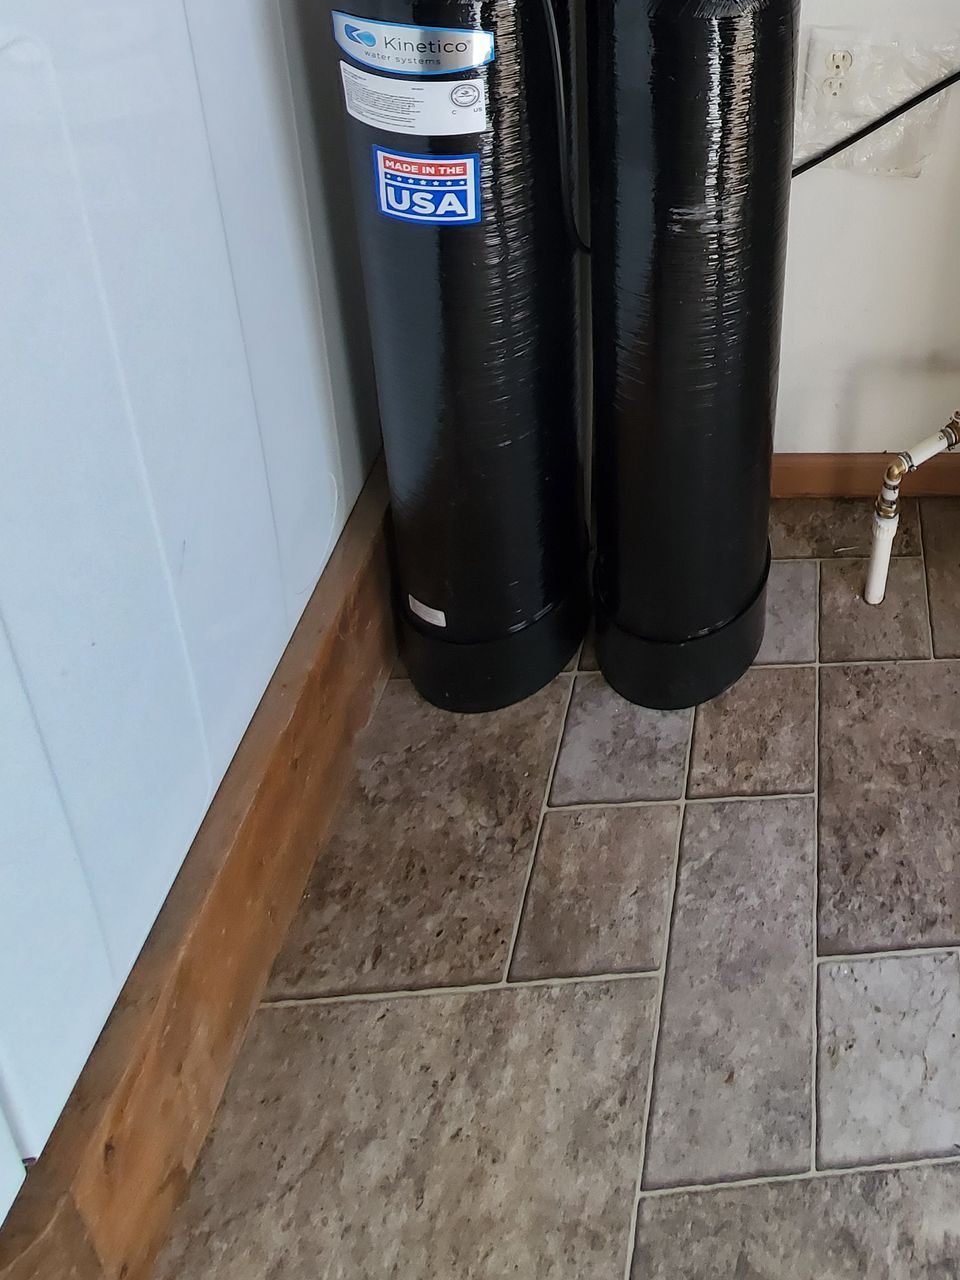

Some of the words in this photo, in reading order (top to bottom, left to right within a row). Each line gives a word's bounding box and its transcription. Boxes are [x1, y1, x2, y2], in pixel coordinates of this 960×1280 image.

[383, 36, 468, 53] Kinetico
[364, 50, 391, 61] water
[395, 56, 442, 65] systems
[385, 160, 419, 173] MADE
[421, 166, 435, 174] IN
[438, 166, 464, 174] THE
[386, 186, 466, 215] USA
